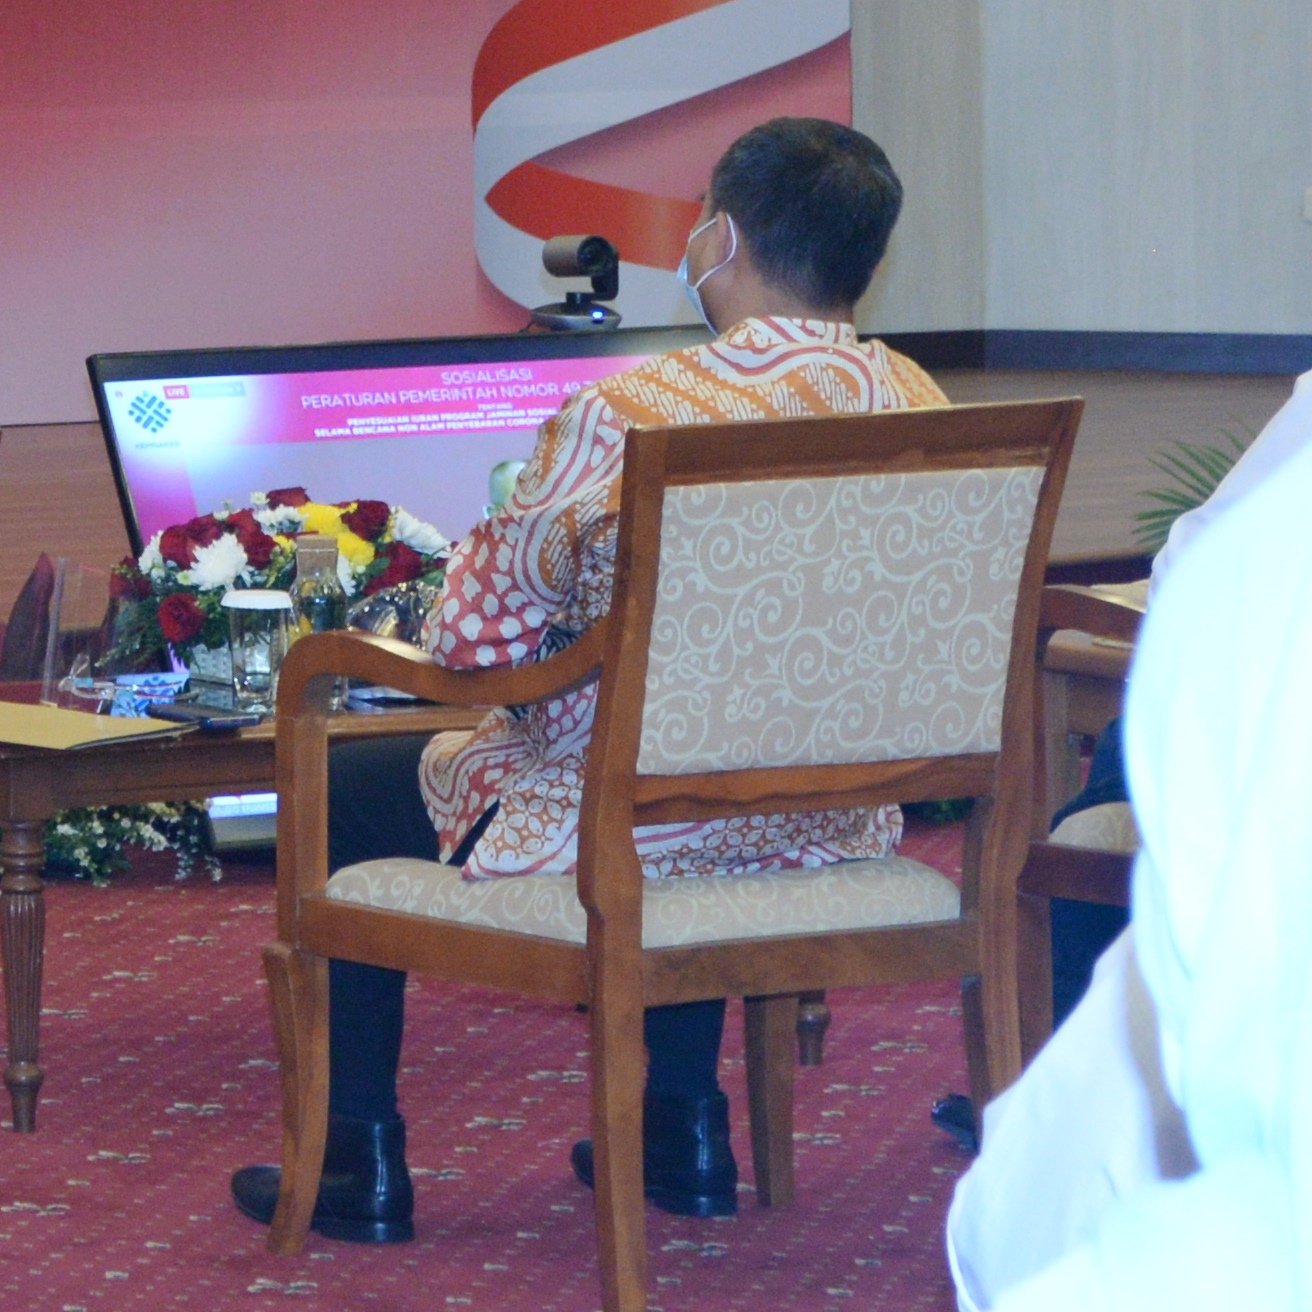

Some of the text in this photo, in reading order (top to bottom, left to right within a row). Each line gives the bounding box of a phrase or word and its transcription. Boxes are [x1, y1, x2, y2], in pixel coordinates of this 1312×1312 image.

[441, 368, 533, 385] SOSIALISASI
[301, 382, 581, 409] PERATURAN PEMERINTAH NOMOR 49
[440, 412, 484, 421] PROGRAM
[486, 410, 526, 419] JAMINAN
[527, 408, 557, 417] SOSIAL
[314, 428, 351, 438] SELAMA
